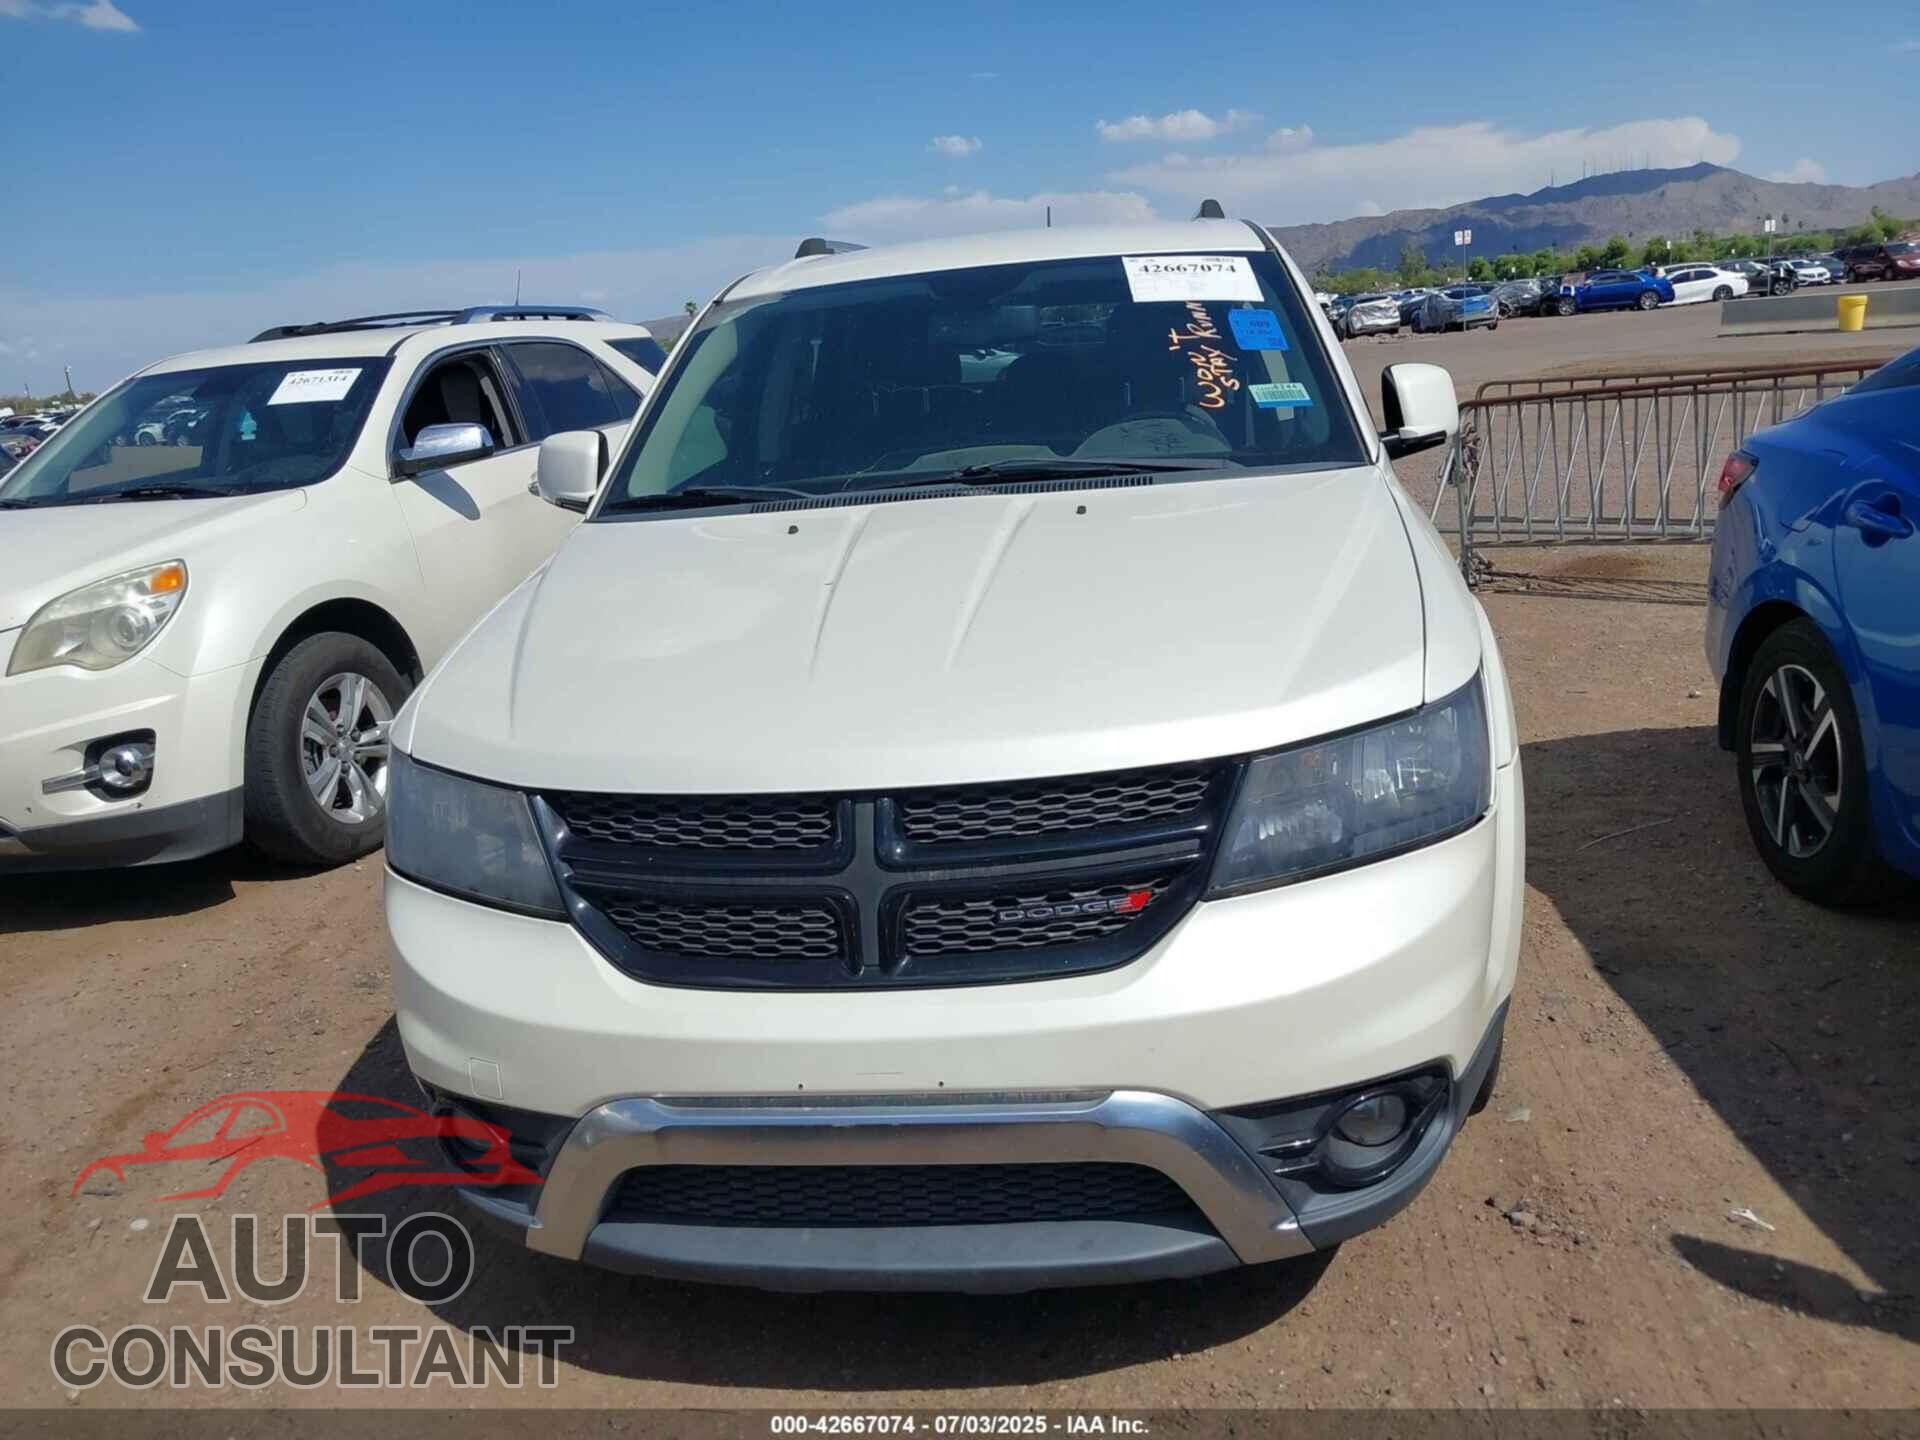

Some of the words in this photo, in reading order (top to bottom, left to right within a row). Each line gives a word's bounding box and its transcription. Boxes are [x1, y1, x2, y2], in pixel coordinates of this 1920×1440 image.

[1138, 264, 1236, 273] 42667074
[1201, 344, 1241, 391] STAY
[999, 896, 1134, 922] DODGE
